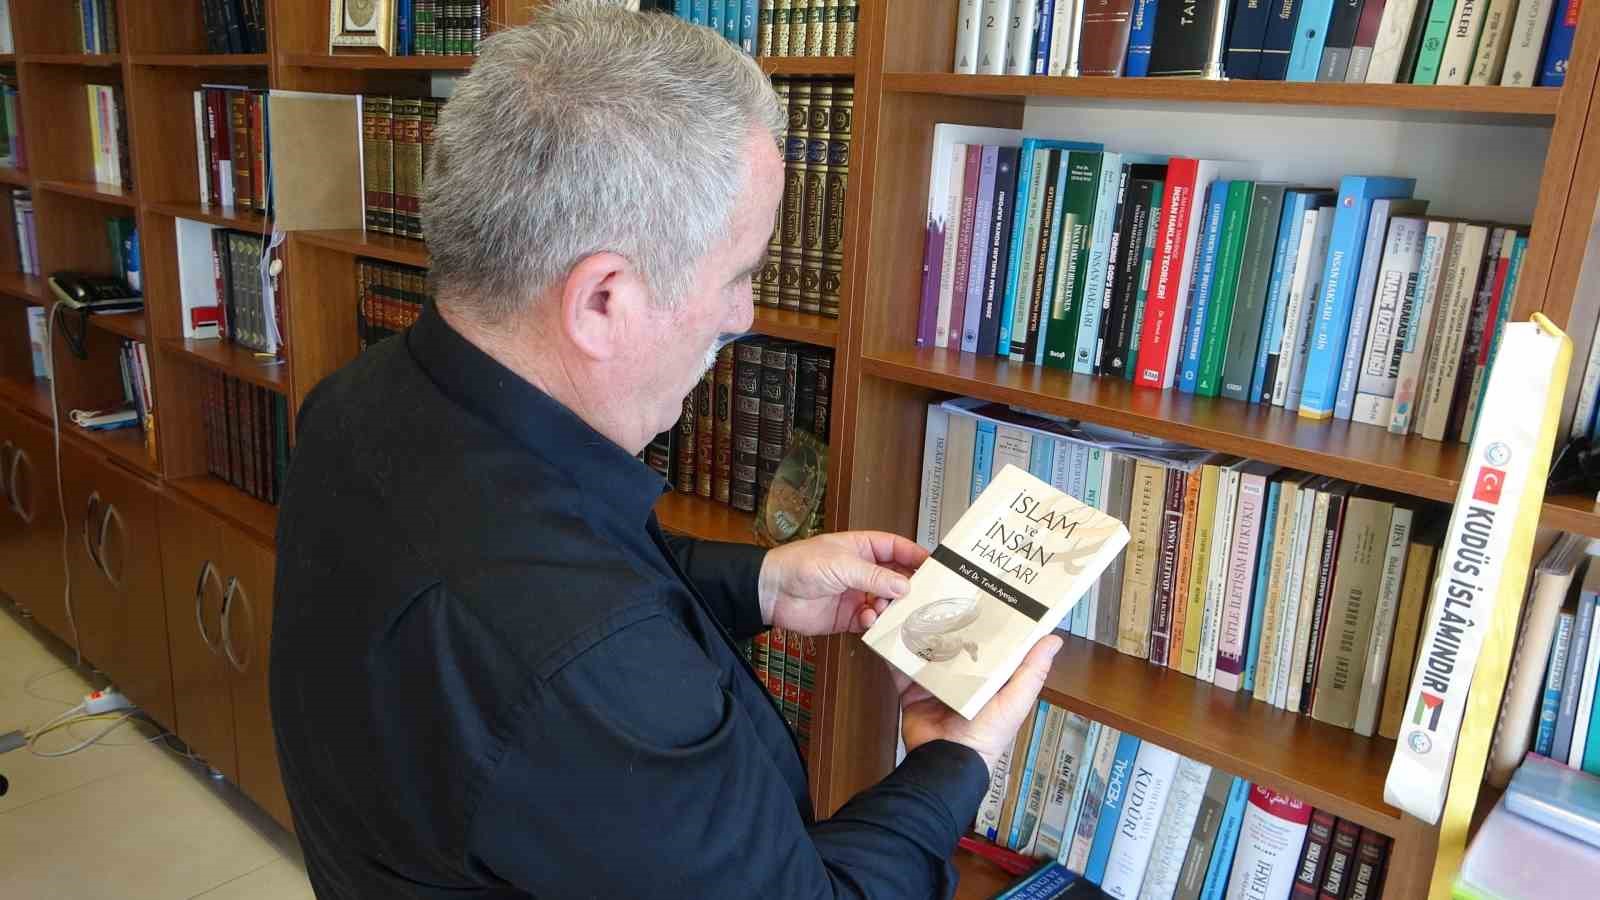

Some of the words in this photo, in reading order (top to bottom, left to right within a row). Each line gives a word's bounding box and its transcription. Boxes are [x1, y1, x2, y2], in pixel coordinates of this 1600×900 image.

[711, 16, 718, 29] 3
[727, 18, 734, 32] 4
[743, 15, 751, 29] 5
[963, 19, 970, 31] 1
[986, 15, 995, 28] 2
[1012, 15, 1022, 29] 3
[1169, 185, 1182, 214] İNSAN
[1163, 214, 1177, 254] HAKLARI
[990, 247, 999, 278] HAKLARI
[1156, 254, 1172, 299] TEORİLERİ
[1329, 250, 1344, 279] İNSAN
[987, 279, 995, 300] İNSAN
[1082, 283, 1098, 328] HAKLARI
[1321, 279, 1338, 321] HAKLARI
[1396, 270, 1418, 338] ULUSLARARASI
[1316, 333, 1329, 350] DİN
[1009, 488, 1080, 540] İSLAM
[1138, 475, 1152, 533] FELSEFESİ
[985, 517, 1056, 568] İNSAN
[1025, 523, 1039, 537] ve
[1166, 519, 1178, 549] YAŞAM
[1236, 500, 1255, 555] HUKUKU
[1452, 504, 1496, 578] KUDÜS
[970, 539, 1040, 585] HAKLARI
[1134, 537, 1146, 575] HUKUK
[1228, 557, 1248, 609] İLETİŞİM
[1223, 610, 1240, 645] KİTLE
[1420, 577, 1481, 694] İSLÂMINDIR
[1103, 757, 1129, 809] MEDHAL
[1298, 859, 1318, 883] İSLAM
[1322, 869, 1344, 894] İSLAM
